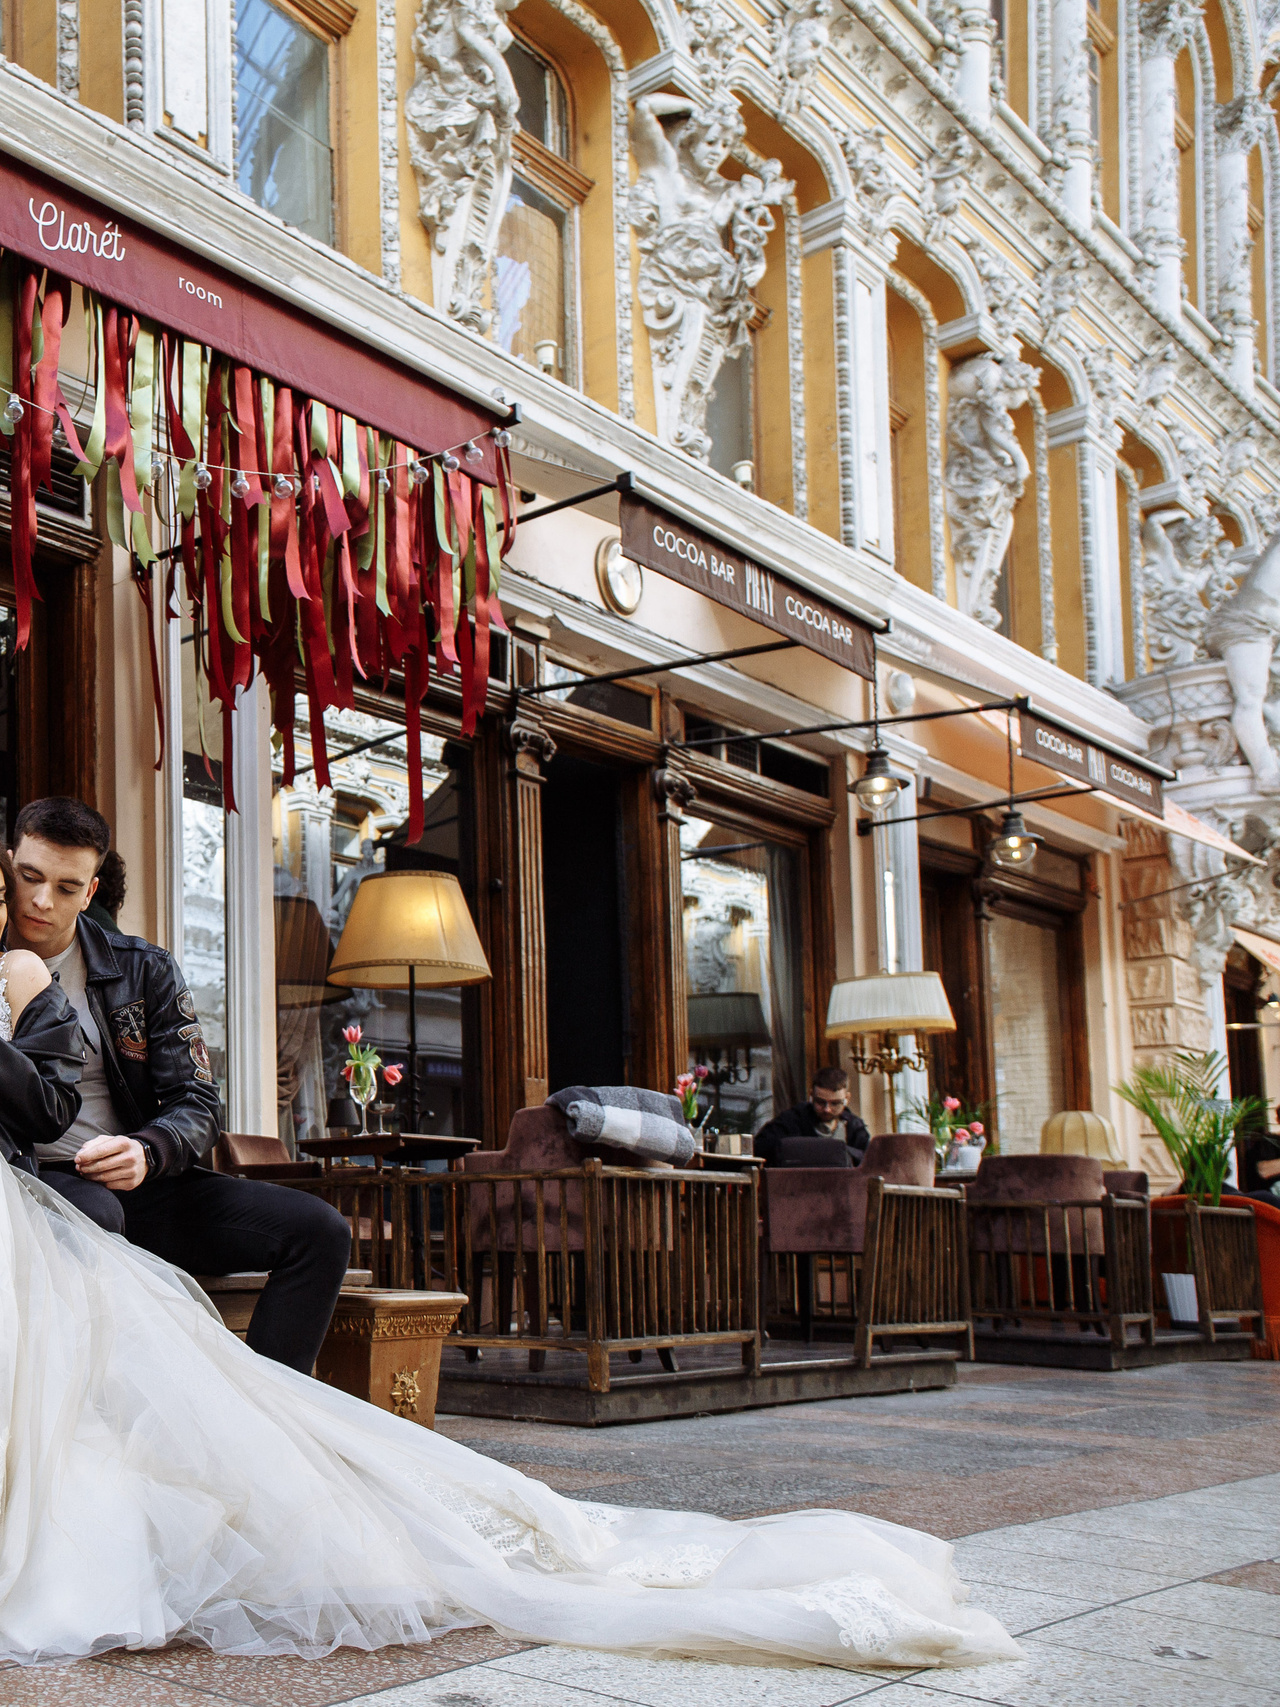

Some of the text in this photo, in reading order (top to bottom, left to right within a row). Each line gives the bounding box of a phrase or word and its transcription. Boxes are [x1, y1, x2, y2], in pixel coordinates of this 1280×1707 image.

[28, 197, 126, 262] Clarét
[177, 275, 223, 309] room
[652, 525, 854, 647] COCOA BAR PRAY COCOA BAR
[1035, 728, 1068, 756] COCOA
[1067, 743, 1084, 764] BAR
[1109, 763, 1138, 790] COCOA
[1137, 776, 1153, 797] BAR
